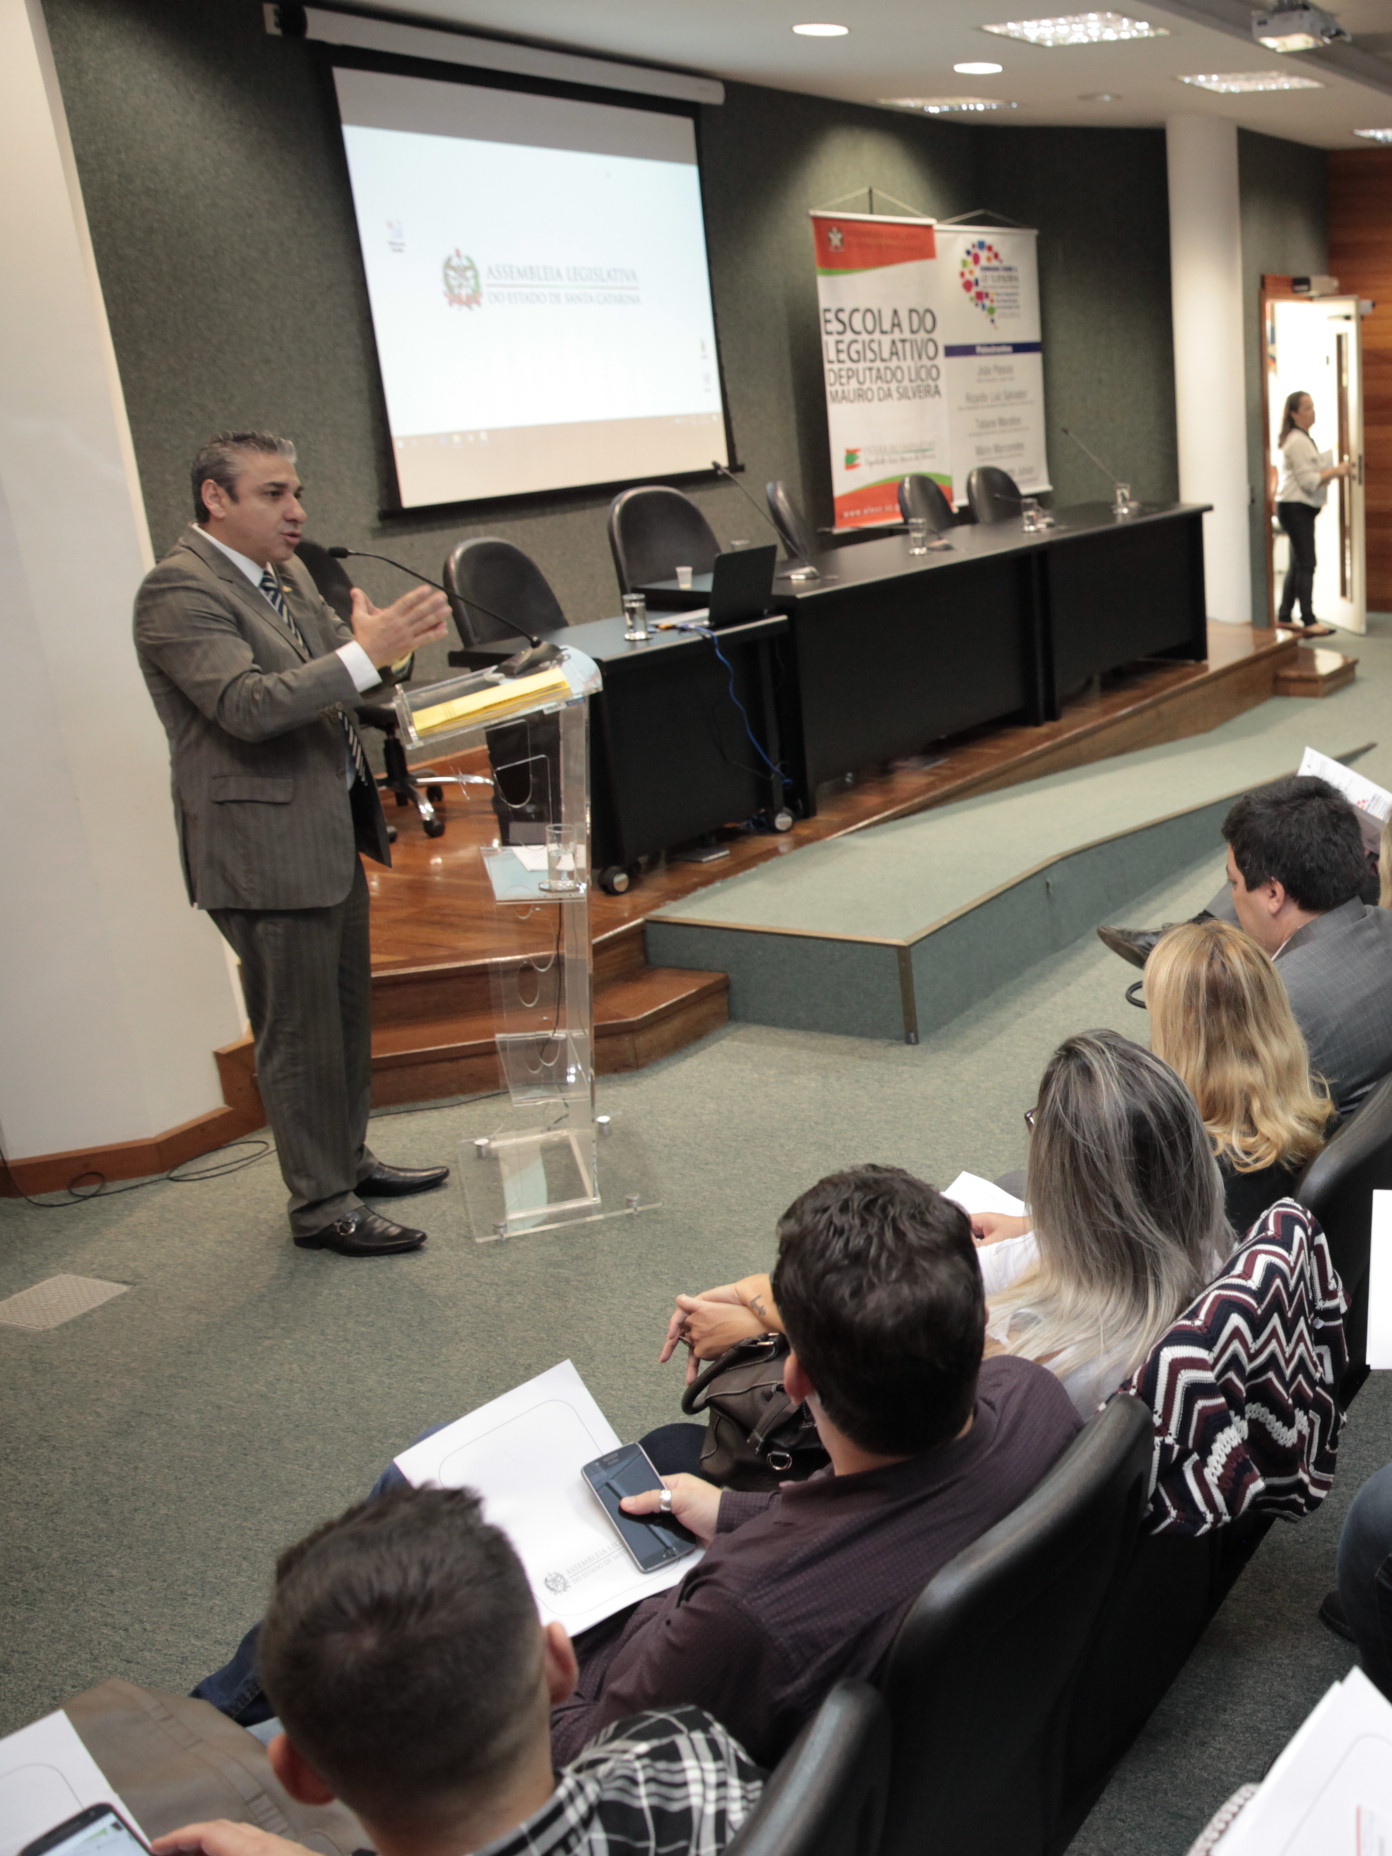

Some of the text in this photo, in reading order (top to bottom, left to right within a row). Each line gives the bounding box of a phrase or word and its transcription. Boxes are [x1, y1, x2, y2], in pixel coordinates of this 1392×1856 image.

[486, 263, 640, 284] ASSEMBLEIA LEGISLATIVA
[823, 308, 937, 335] ESCOLA DO
[824, 337, 939, 364] LEGISLATIVO
[827, 362, 941, 387] DEPUTADO LÍCIO
[829, 384, 942, 404] MAURO DA SILVEIRA
